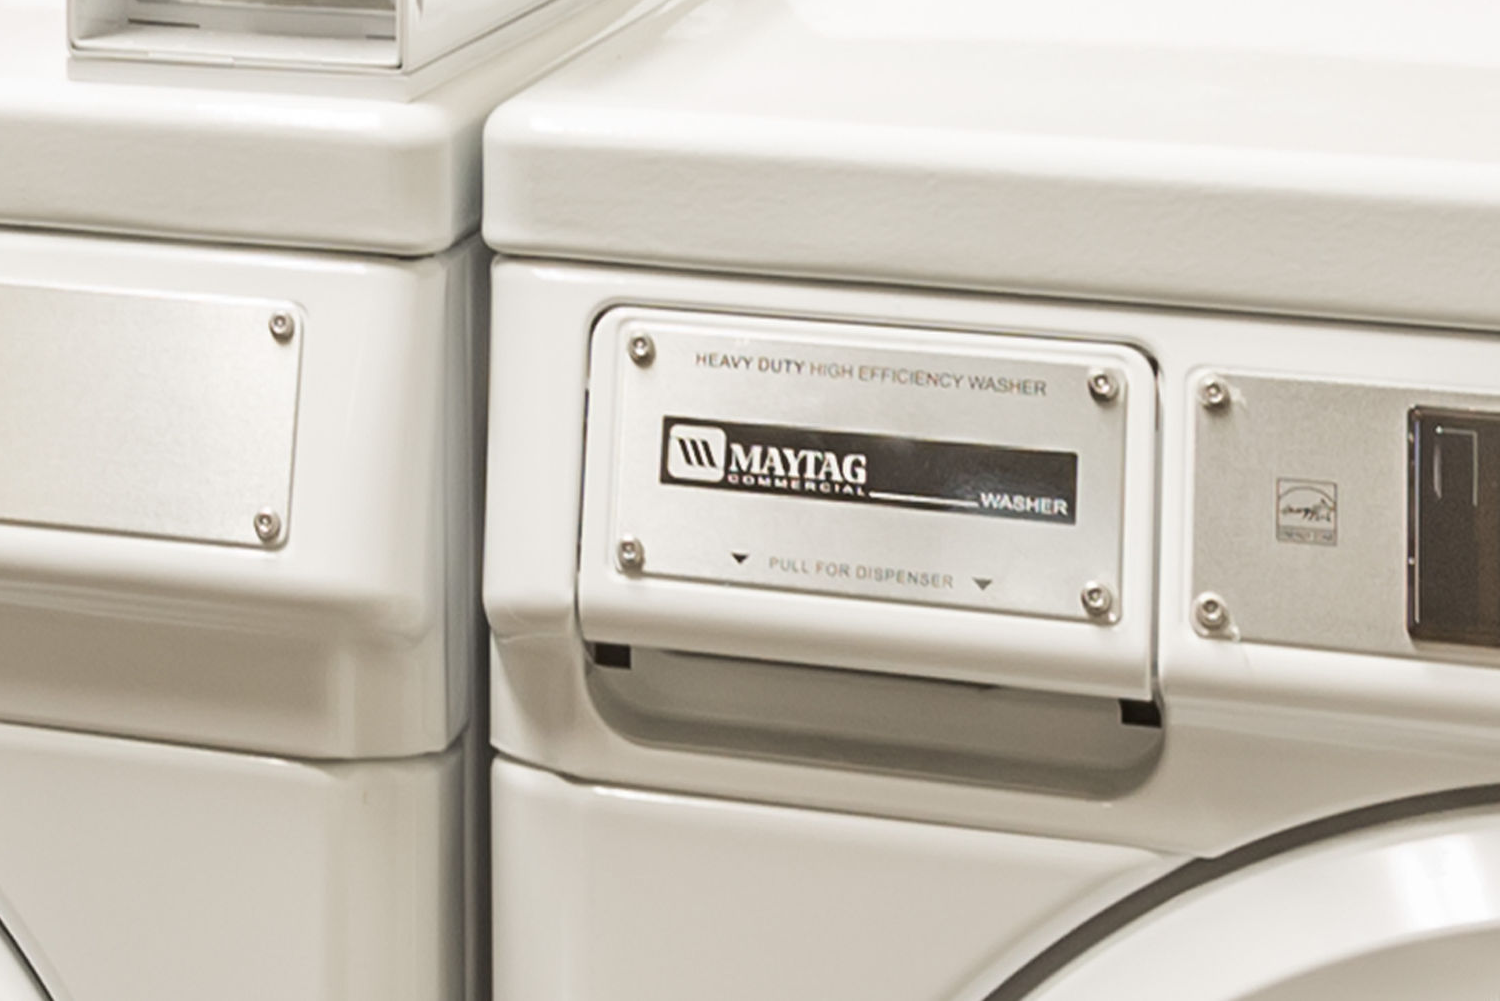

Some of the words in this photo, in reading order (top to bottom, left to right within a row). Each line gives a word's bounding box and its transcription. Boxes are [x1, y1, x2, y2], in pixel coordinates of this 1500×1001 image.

[695, 353, 753, 370] HEAVY
[758, 357, 804, 374] DUTY
[810, 361, 853, 379] HIGH
[858, 365, 963, 389] EFFICIENCY
[968, 375, 1047, 396] WASHER
[728, 443, 867, 483] MAYTAG
[727, 474, 866, 497] COMMERCIAL
[980, 491, 1068, 516] WASHER
[769, 556, 810, 574] PULL
[815, 560, 850, 578] FOR
[855, 565, 954, 588] DISPENSER
